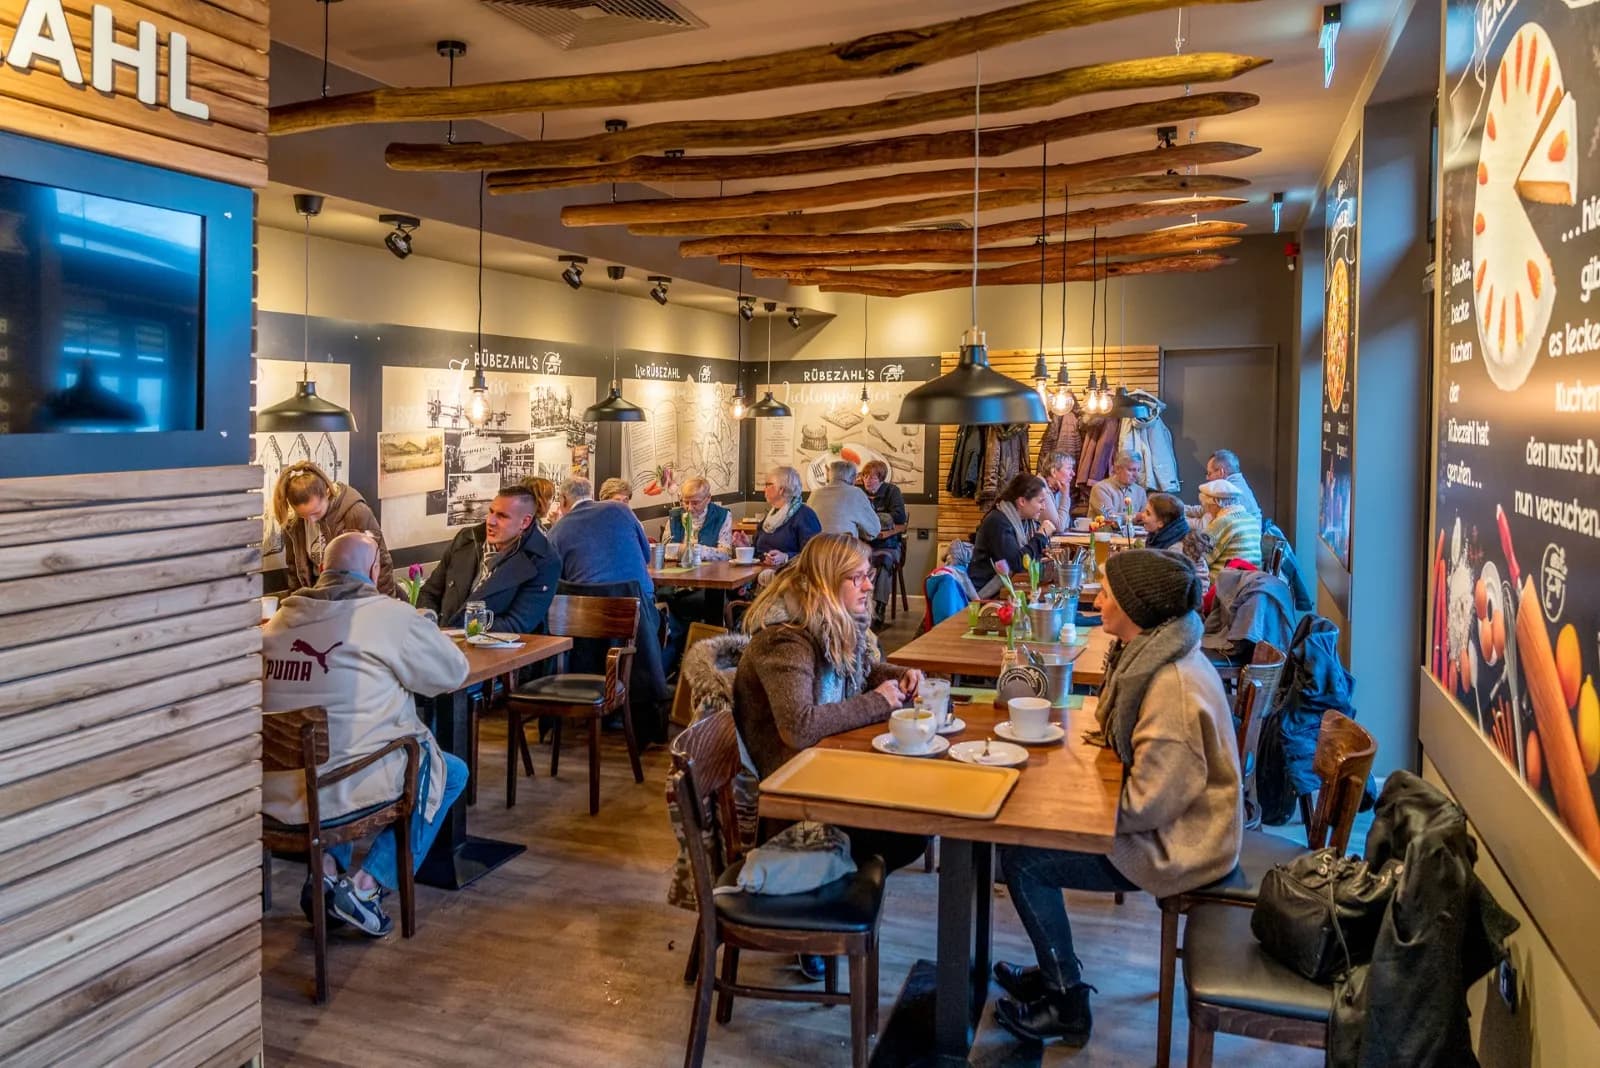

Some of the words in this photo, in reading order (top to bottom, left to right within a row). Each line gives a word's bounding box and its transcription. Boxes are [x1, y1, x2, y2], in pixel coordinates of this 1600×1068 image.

[1548, 331, 1563, 358] es
[1526, 436, 1547, 467] den
[1548, 439, 1584, 473] musst
[1514, 490, 1533, 517] nun
[265, 659, 312, 682] PUMA
